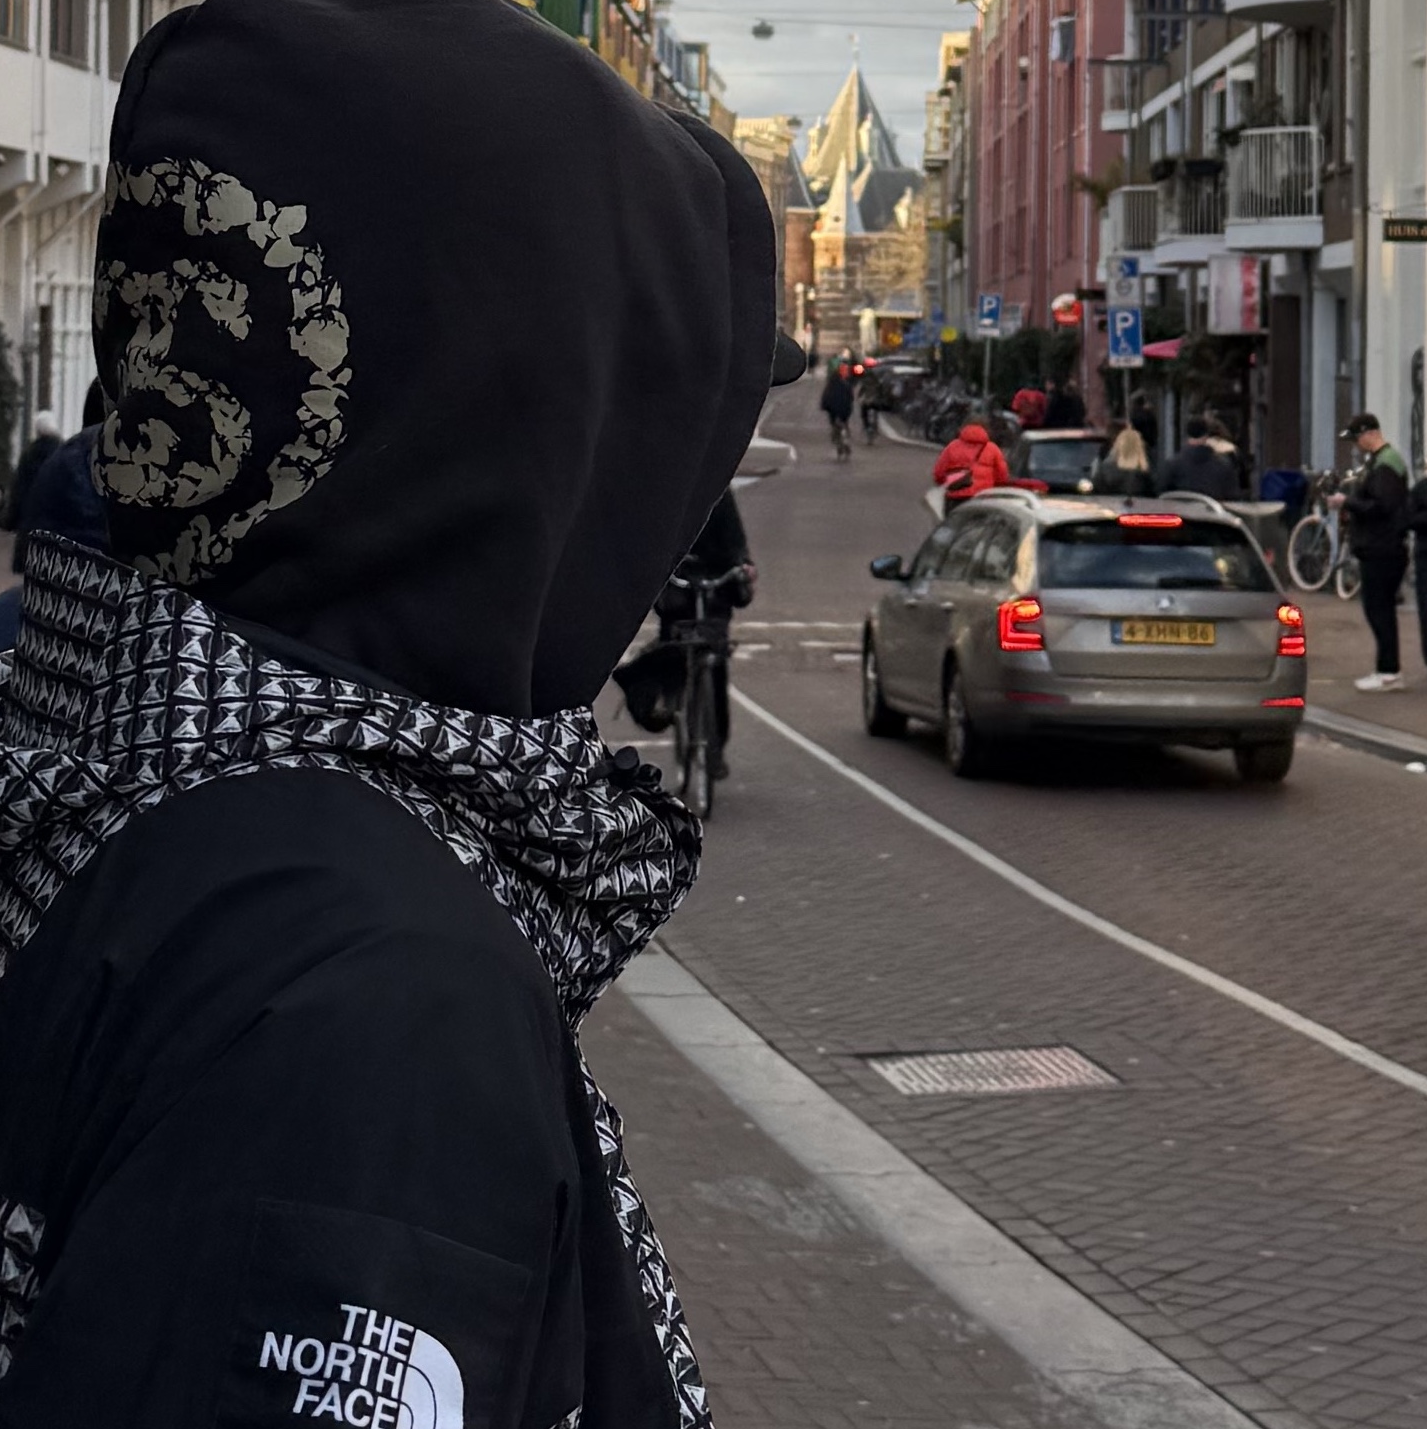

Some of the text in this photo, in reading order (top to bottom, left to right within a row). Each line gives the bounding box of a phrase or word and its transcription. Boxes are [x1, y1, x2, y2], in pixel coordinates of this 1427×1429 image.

[1115, 311, 1134, 338] P
[340, 1304, 414, 1362] THE
[259, 1331, 404, 1399] NORTH
